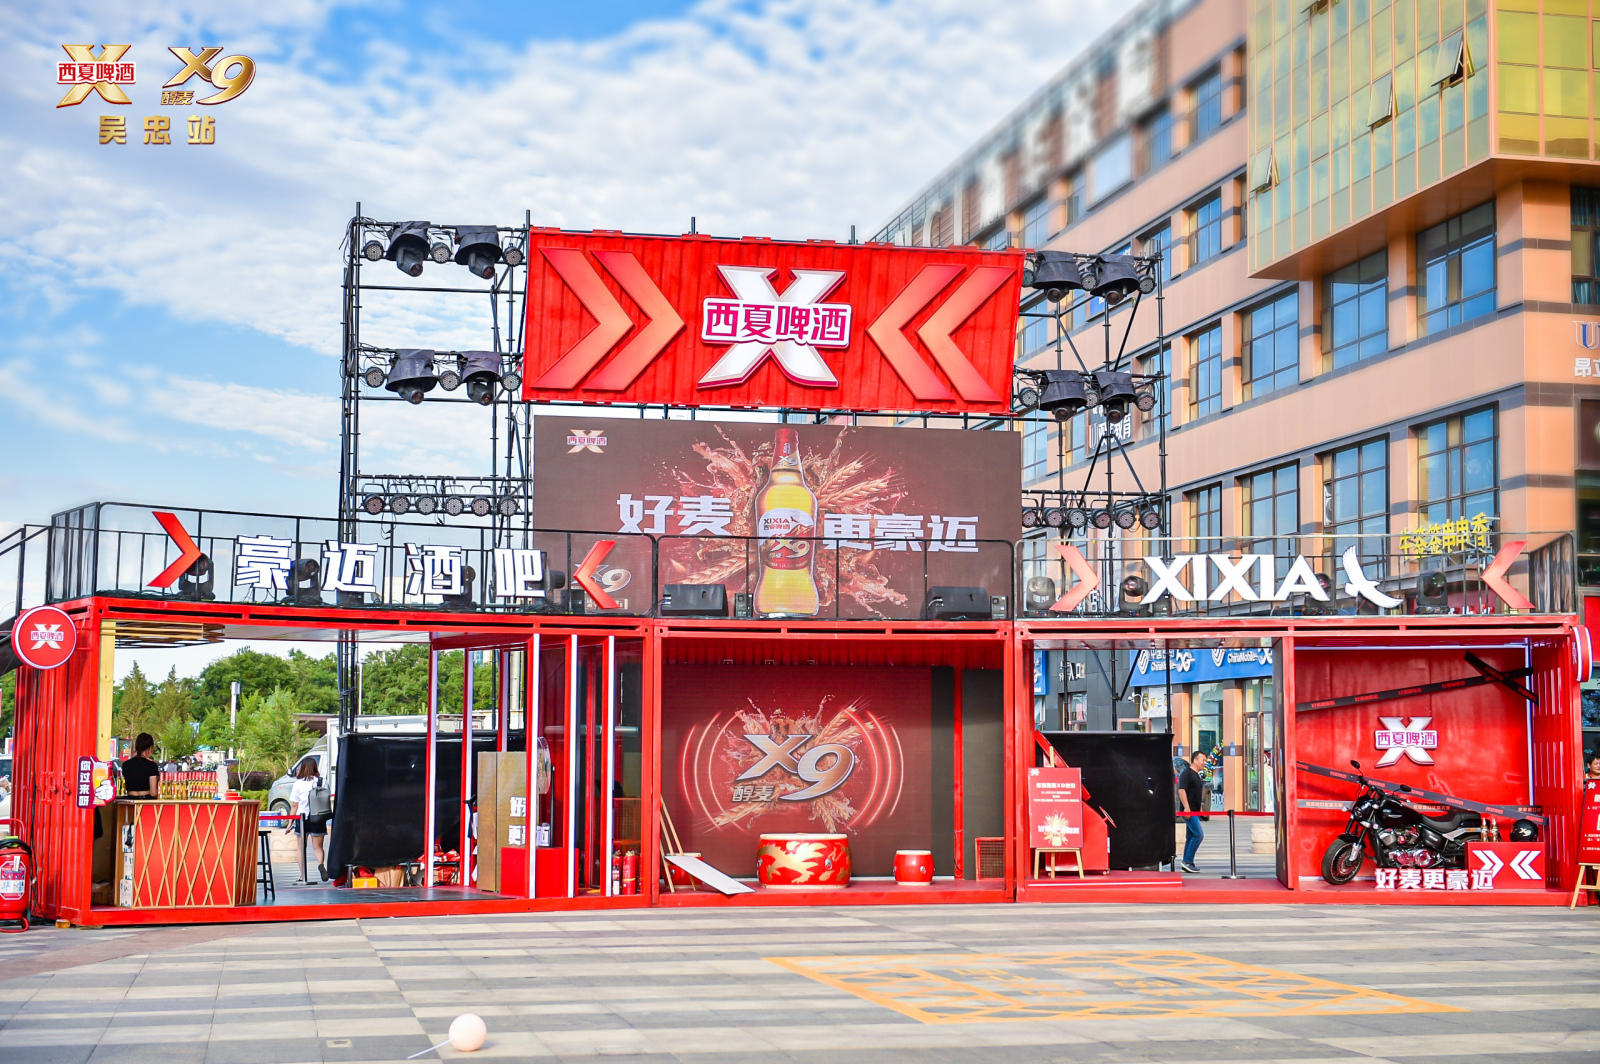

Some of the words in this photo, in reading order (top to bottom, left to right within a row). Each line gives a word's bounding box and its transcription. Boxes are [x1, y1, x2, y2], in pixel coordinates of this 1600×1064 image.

[705, 301, 848, 342] 西夏啤酒
[617, 494, 733, 536] 好麦
[823, 513, 979, 552] 更豪迈
[235, 535, 546, 598] 豪迈酒吧
[1140, 554, 1330, 605] XIXIA
[1377, 731, 1437, 747] 西夏啤酒
[736, 734, 855, 800] X9
[732, 786, 774, 802] 醇麦
[1375, 868, 1494, 890] 好麦更豪迈
